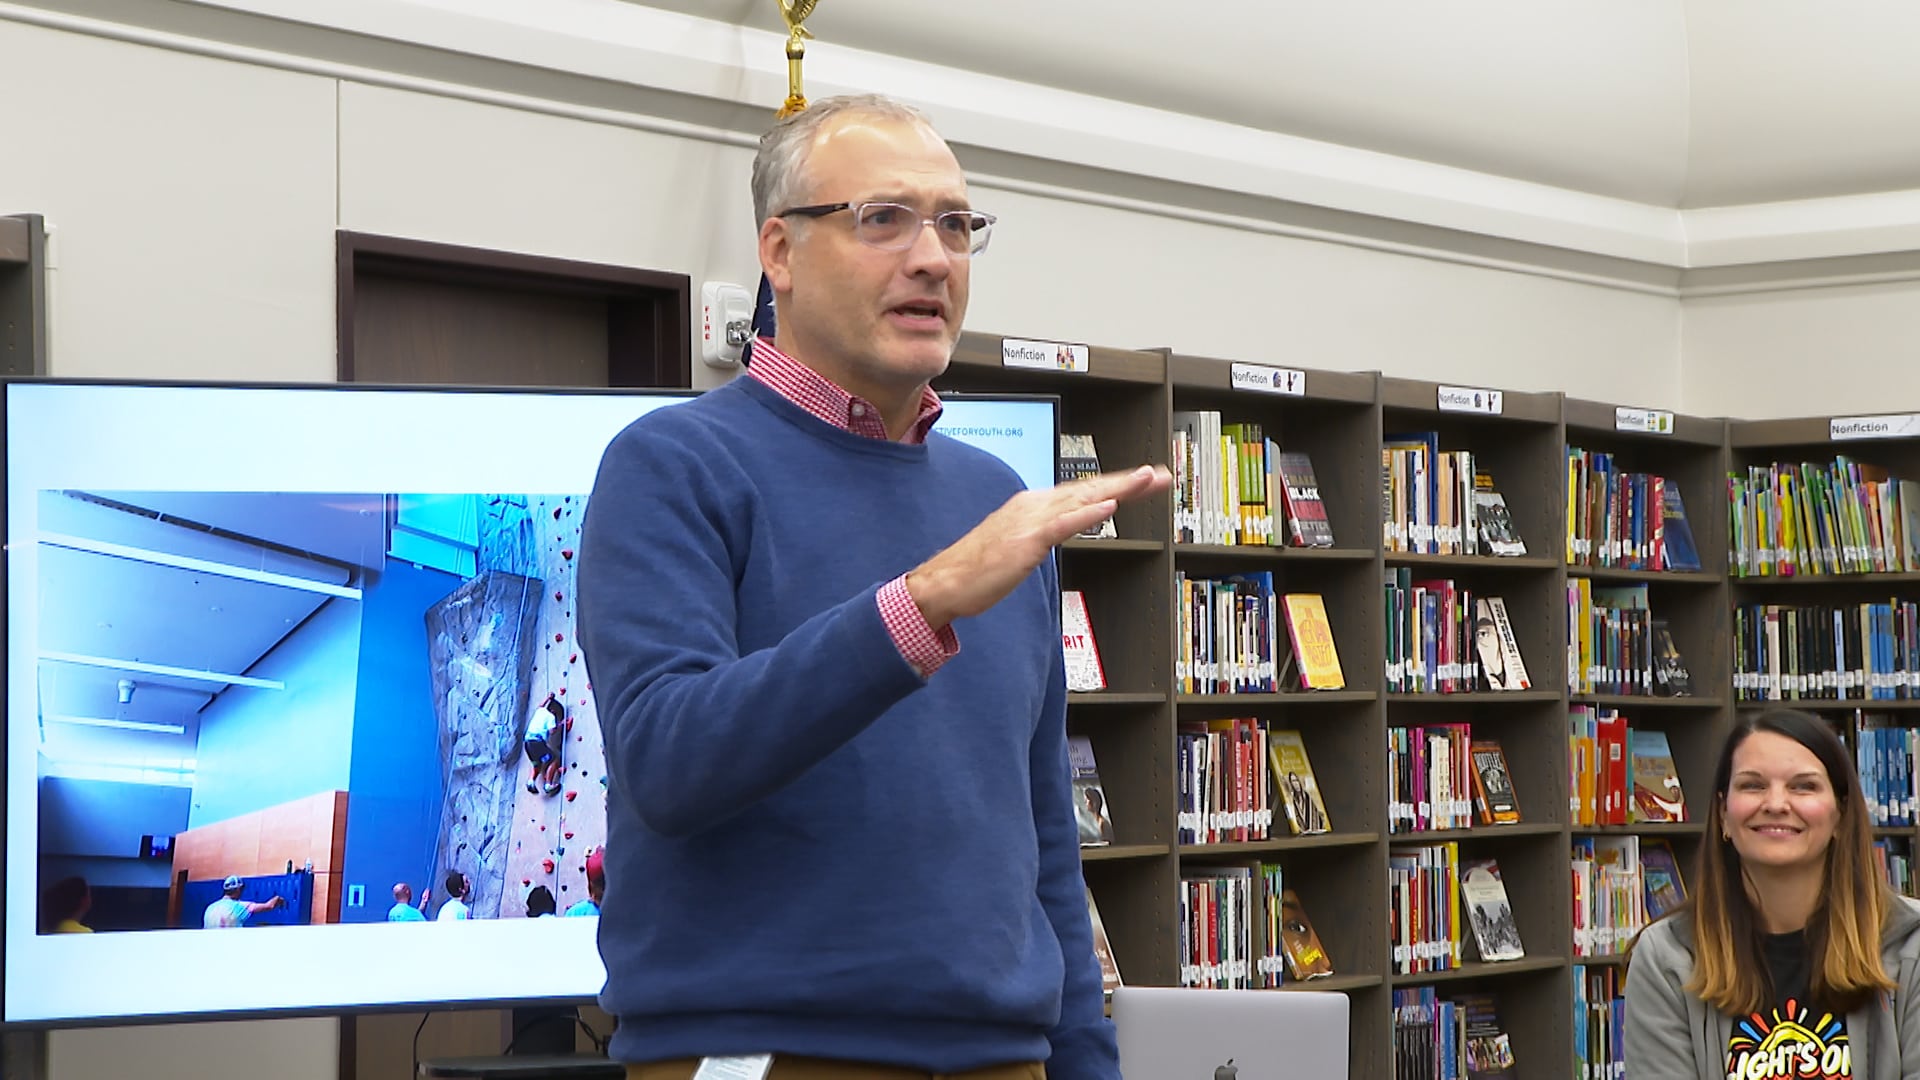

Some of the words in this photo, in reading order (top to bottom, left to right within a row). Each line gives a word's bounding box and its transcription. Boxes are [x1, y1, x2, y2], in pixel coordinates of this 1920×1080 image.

[1004, 346, 1046, 362] Nonfiction
[1232, 370, 1268, 385] Nonfiction
[1439, 393, 1470, 406] Nonfiction
[936, 426, 1024, 438] TIVEFORYOUTH.ORG
[1831, 421, 1889, 434] Nonfiction
[1288, 487, 1321, 501] BLACK
[1062, 634, 1084, 649] RIT
